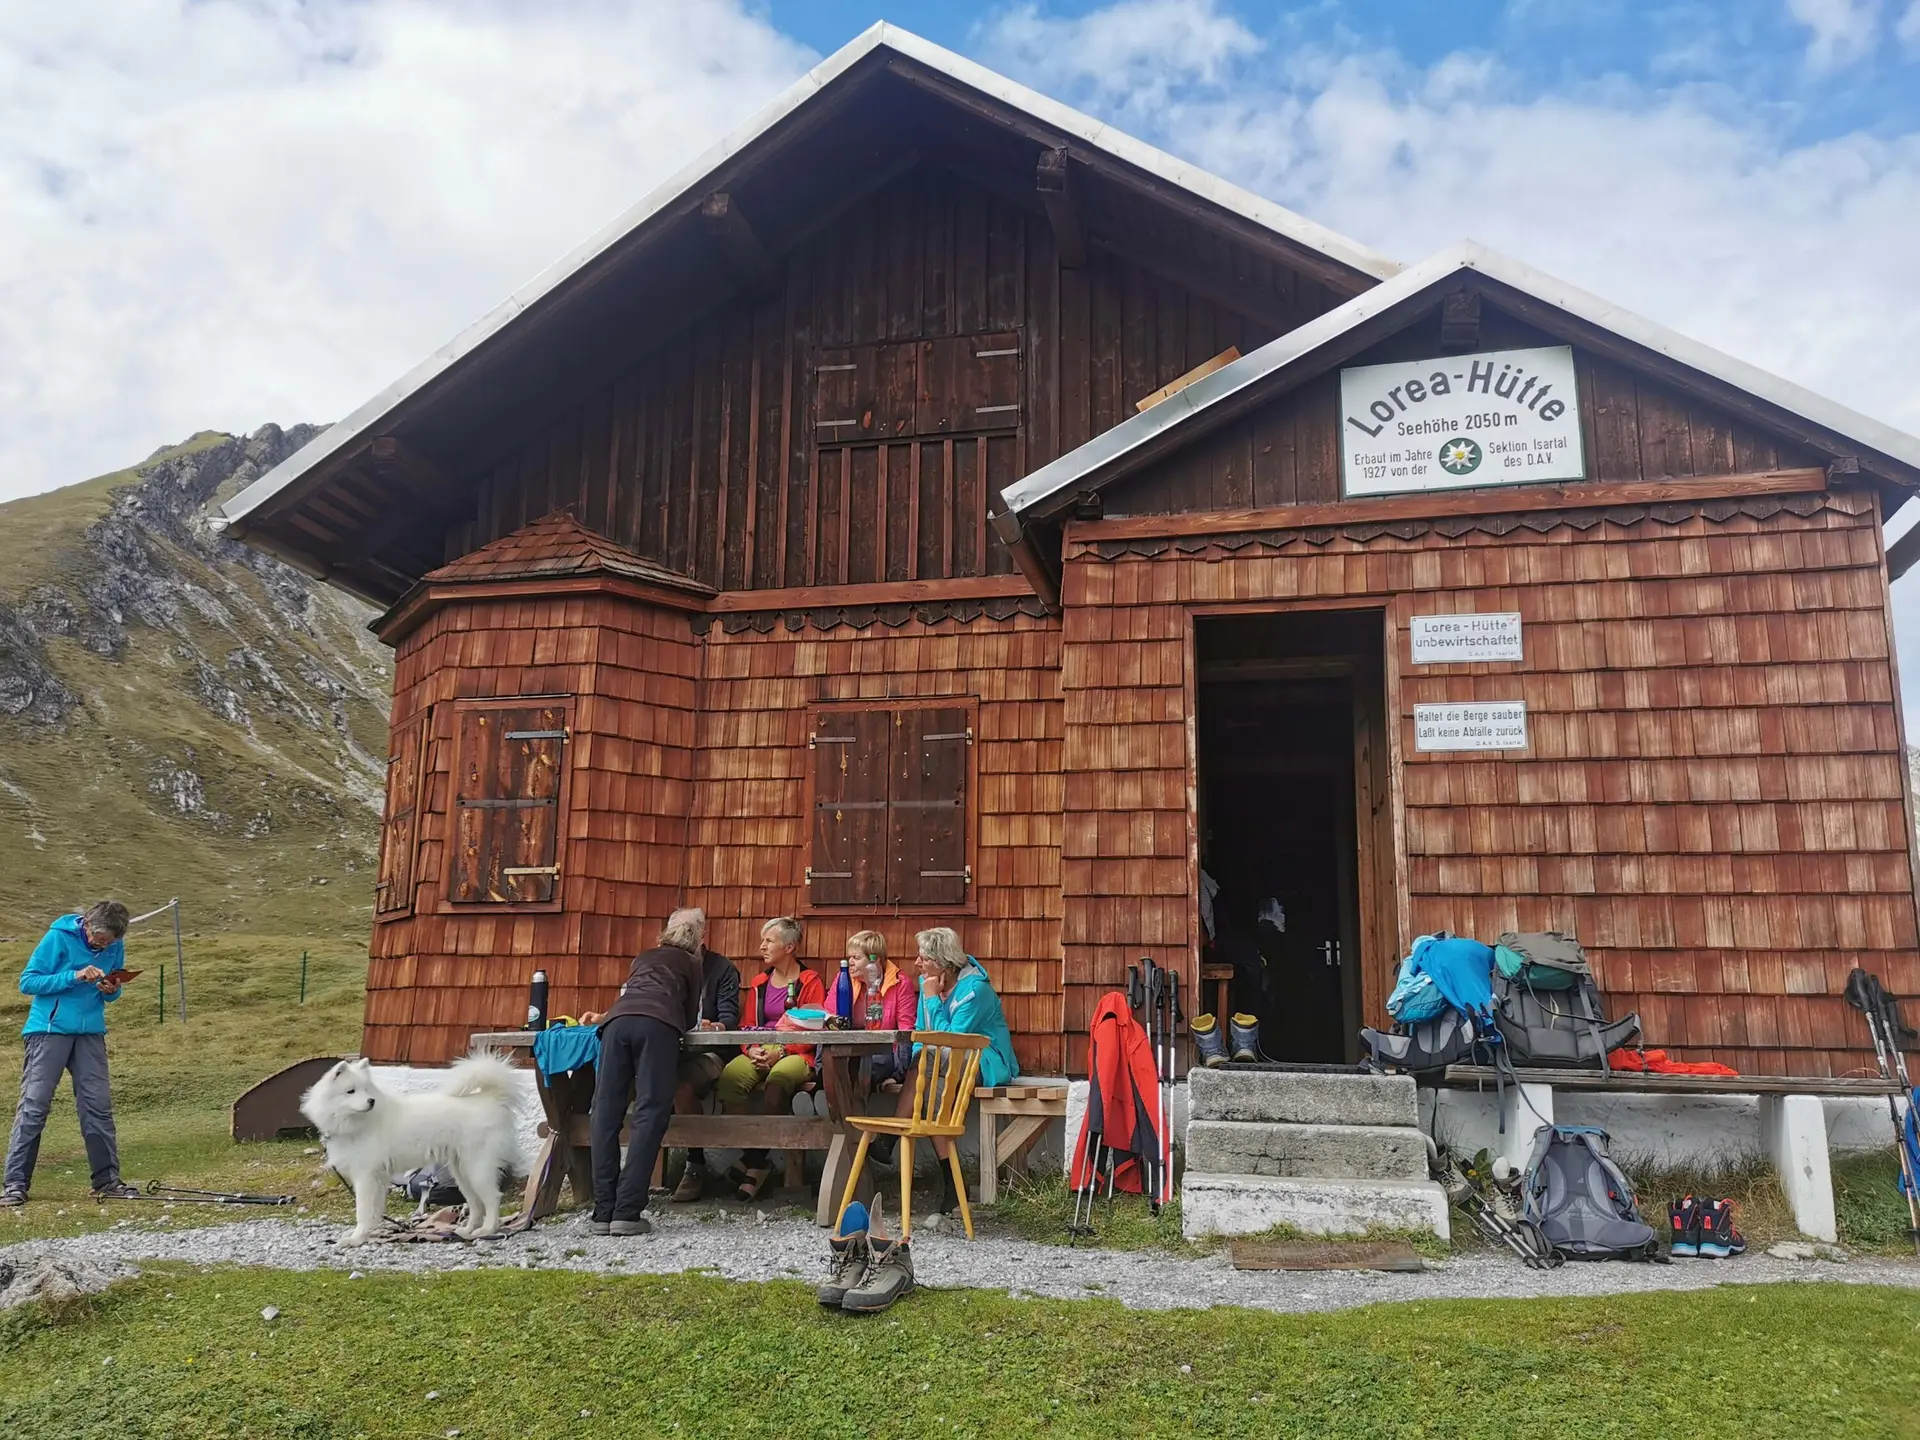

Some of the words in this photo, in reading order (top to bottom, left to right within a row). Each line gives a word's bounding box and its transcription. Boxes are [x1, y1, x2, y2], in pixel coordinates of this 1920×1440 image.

[1347, 360, 1565, 438] Lorea-Hütte
[1398, 418, 1458, 436] Seehöhe
[1466, 413, 1500, 430] 2050
[1505, 415, 1518, 426] m
[1490, 440, 1527, 453] Sektion
[1534, 437, 1567, 450] Isartal
[1355, 453, 1386, 465] Erbaut
[1390, 452, 1401, 462] im
[1405, 449, 1432, 462] Jahre
[1504, 455, 1522, 467] des
[1527, 453, 1553, 465] D.A.V.
[1364, 466, 1386, 478] 1927
[1391, 467, 1408, 476] von
[1411, 464, 1427, 475] der
[1416, 635, 1518, 647] unbewirtschaftet
[1418, 711, 1442, 721] Haltet
[1447, 711, 1459, 721] die
[1464, 710, 1488, 722] Berge
[1492, 709, 1522, 720] sauber
[1419, 728, 1435, 737] Laßt
[1438, 727, 1459, 737] keine
[1463, 727, 1492, 736] Abfälle
[1496, 725, 1523, 736] zurück
